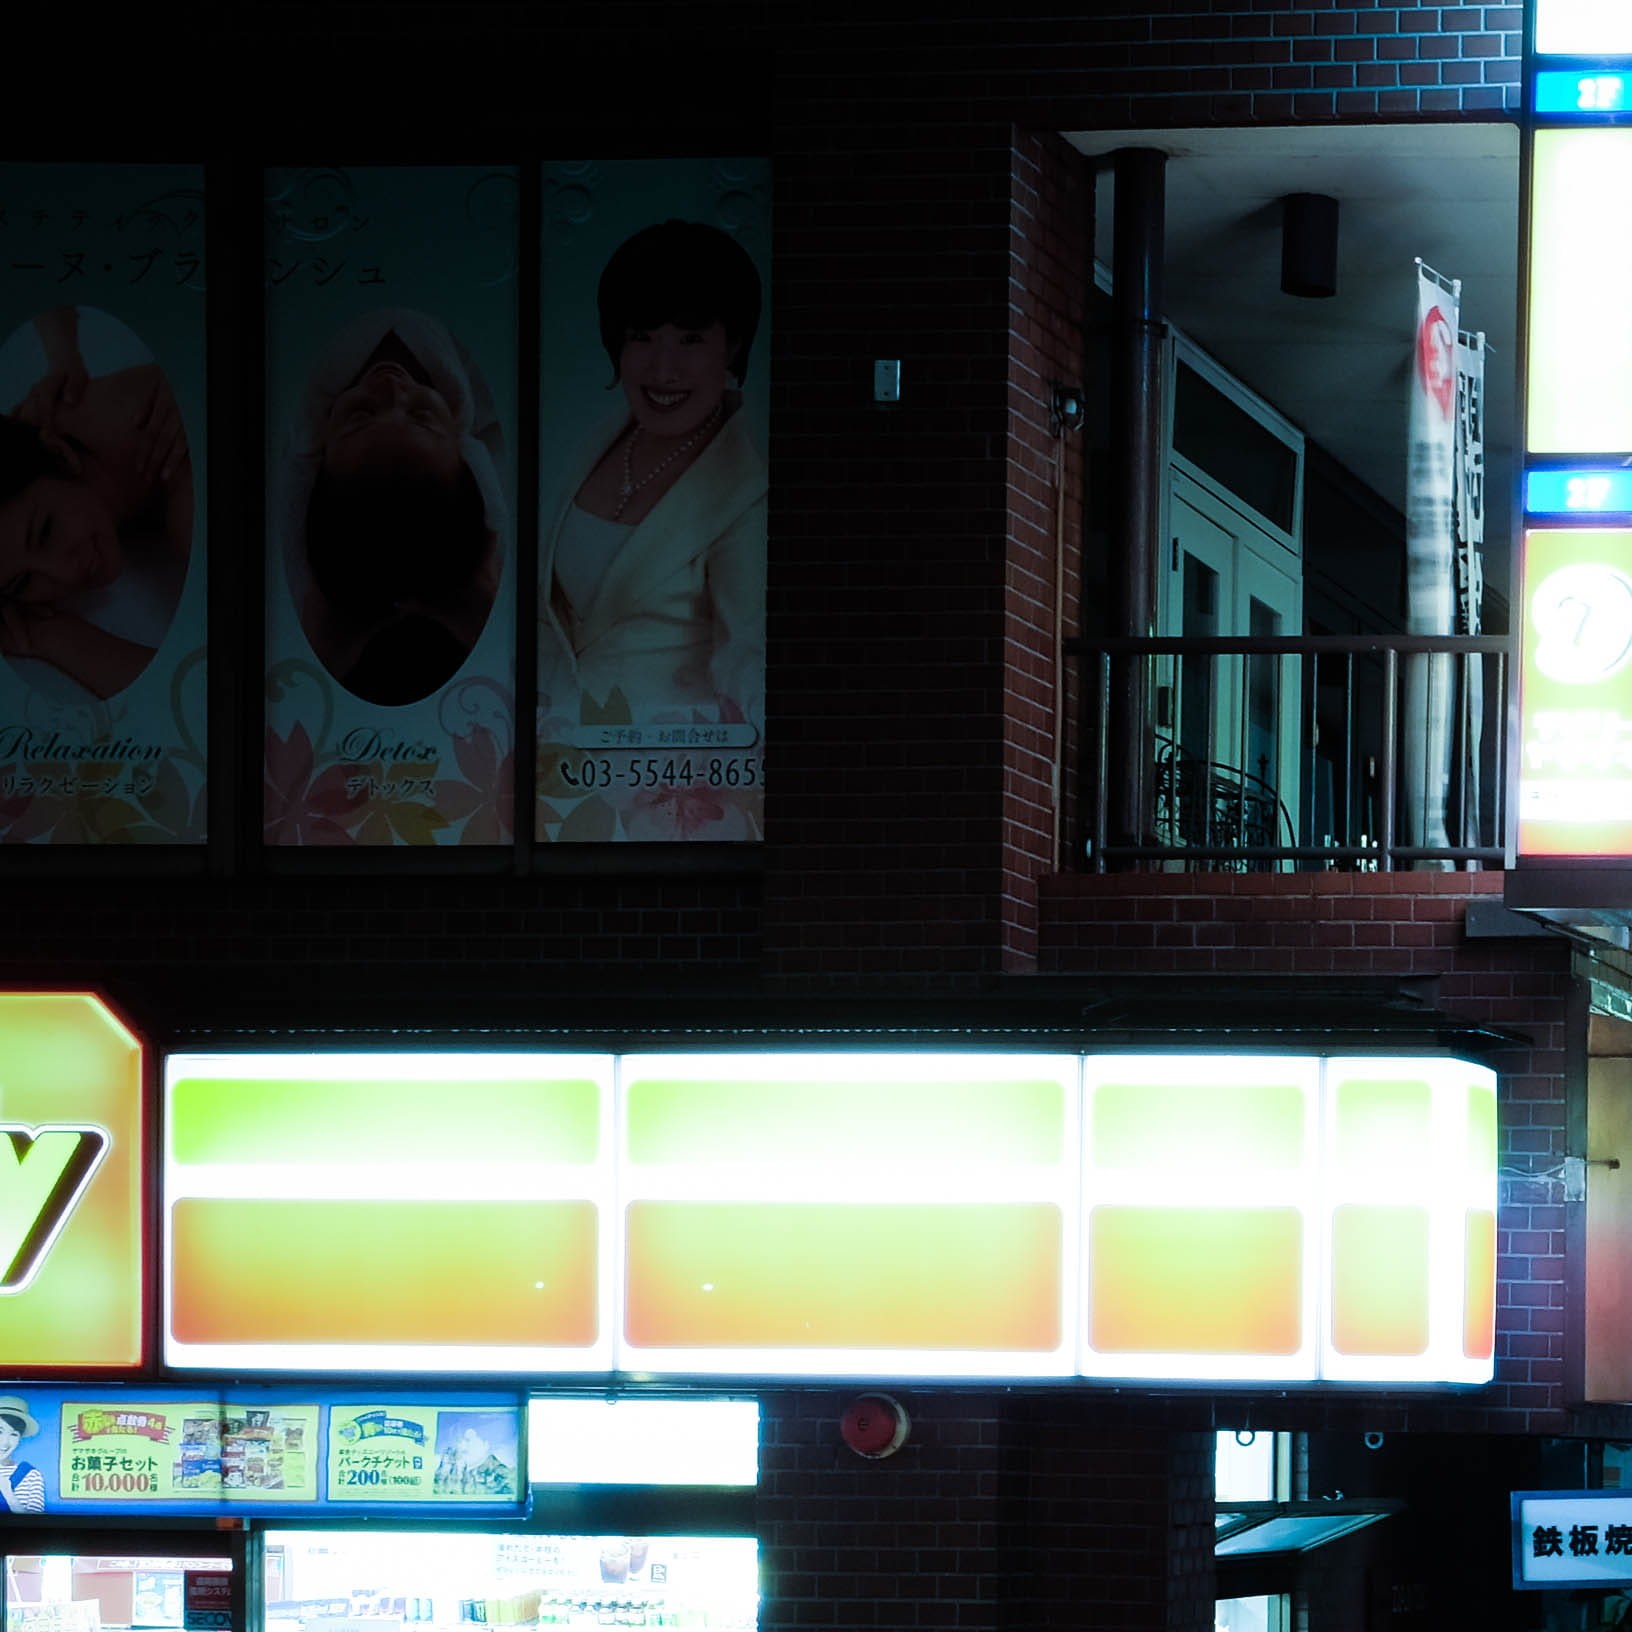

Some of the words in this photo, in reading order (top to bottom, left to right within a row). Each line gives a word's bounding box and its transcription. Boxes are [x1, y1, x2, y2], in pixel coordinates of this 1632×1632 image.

[0, 726, 163, 760] Relaxation
[340, 726, 437, 761] Detox
[3, 774, 153, 799] リラクゼーション
[345, 774, 435, 797] デトックス
[72, 1456, 158, 1472] お菓子セット
[338, 1456, 410, 1469] パークチケット
[83, 1474, 150, 1492] 10,000
[346, 1470, 380, 1486] 200
